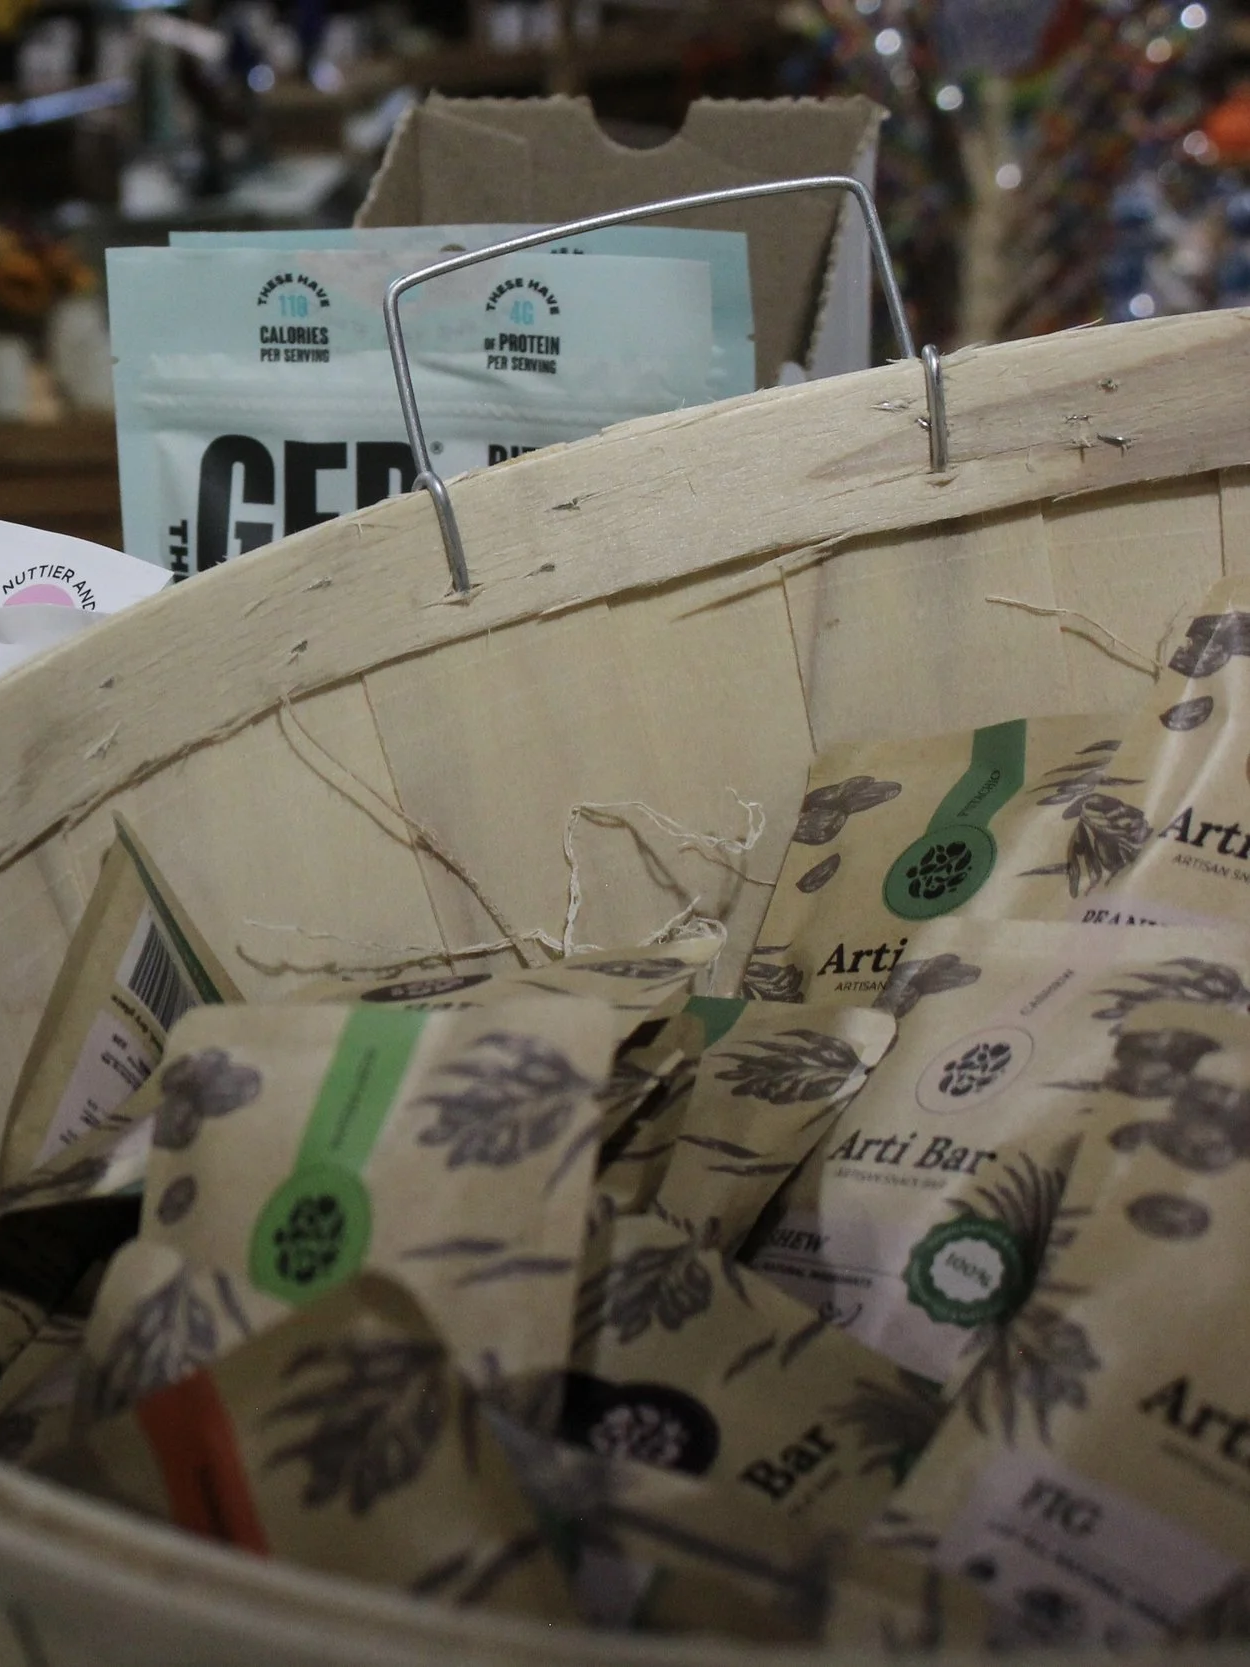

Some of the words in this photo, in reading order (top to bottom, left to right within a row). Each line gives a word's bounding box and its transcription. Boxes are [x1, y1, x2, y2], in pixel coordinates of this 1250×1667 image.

[257, 273, 293, 306] THESE
[297, 275, 330, 307] HAVE
[486, 278, 524, 312] THESE
[528, 279, 560, 315] HAVE
[509, 300, 534, 325] 4G
[260, 325, 329, 346] CALORIES
[499, 333, 560, 355] PROTEIN
[260, 348, 281, 363] PER
[283, 348, 330, 364] SERVING
[486, 354, 508, 371] PER
[510, 355, 557, 375] SERVING
[2, 564, 75, 595] NUTTIER
[1171, 853, 1229, 878] ARTISAN
[817, 938, 908, 976] Arti
[834, 981, 887, 992] ARTISAN
[827, 1128, 918, 1166] Arti
[914, 1135, 998, 1176] Bar
[944, 1251, 993, 1288] 100%
[738, 1424, 837, 1501] Bar
[1019, 1478, 1103, 1539] FIG
